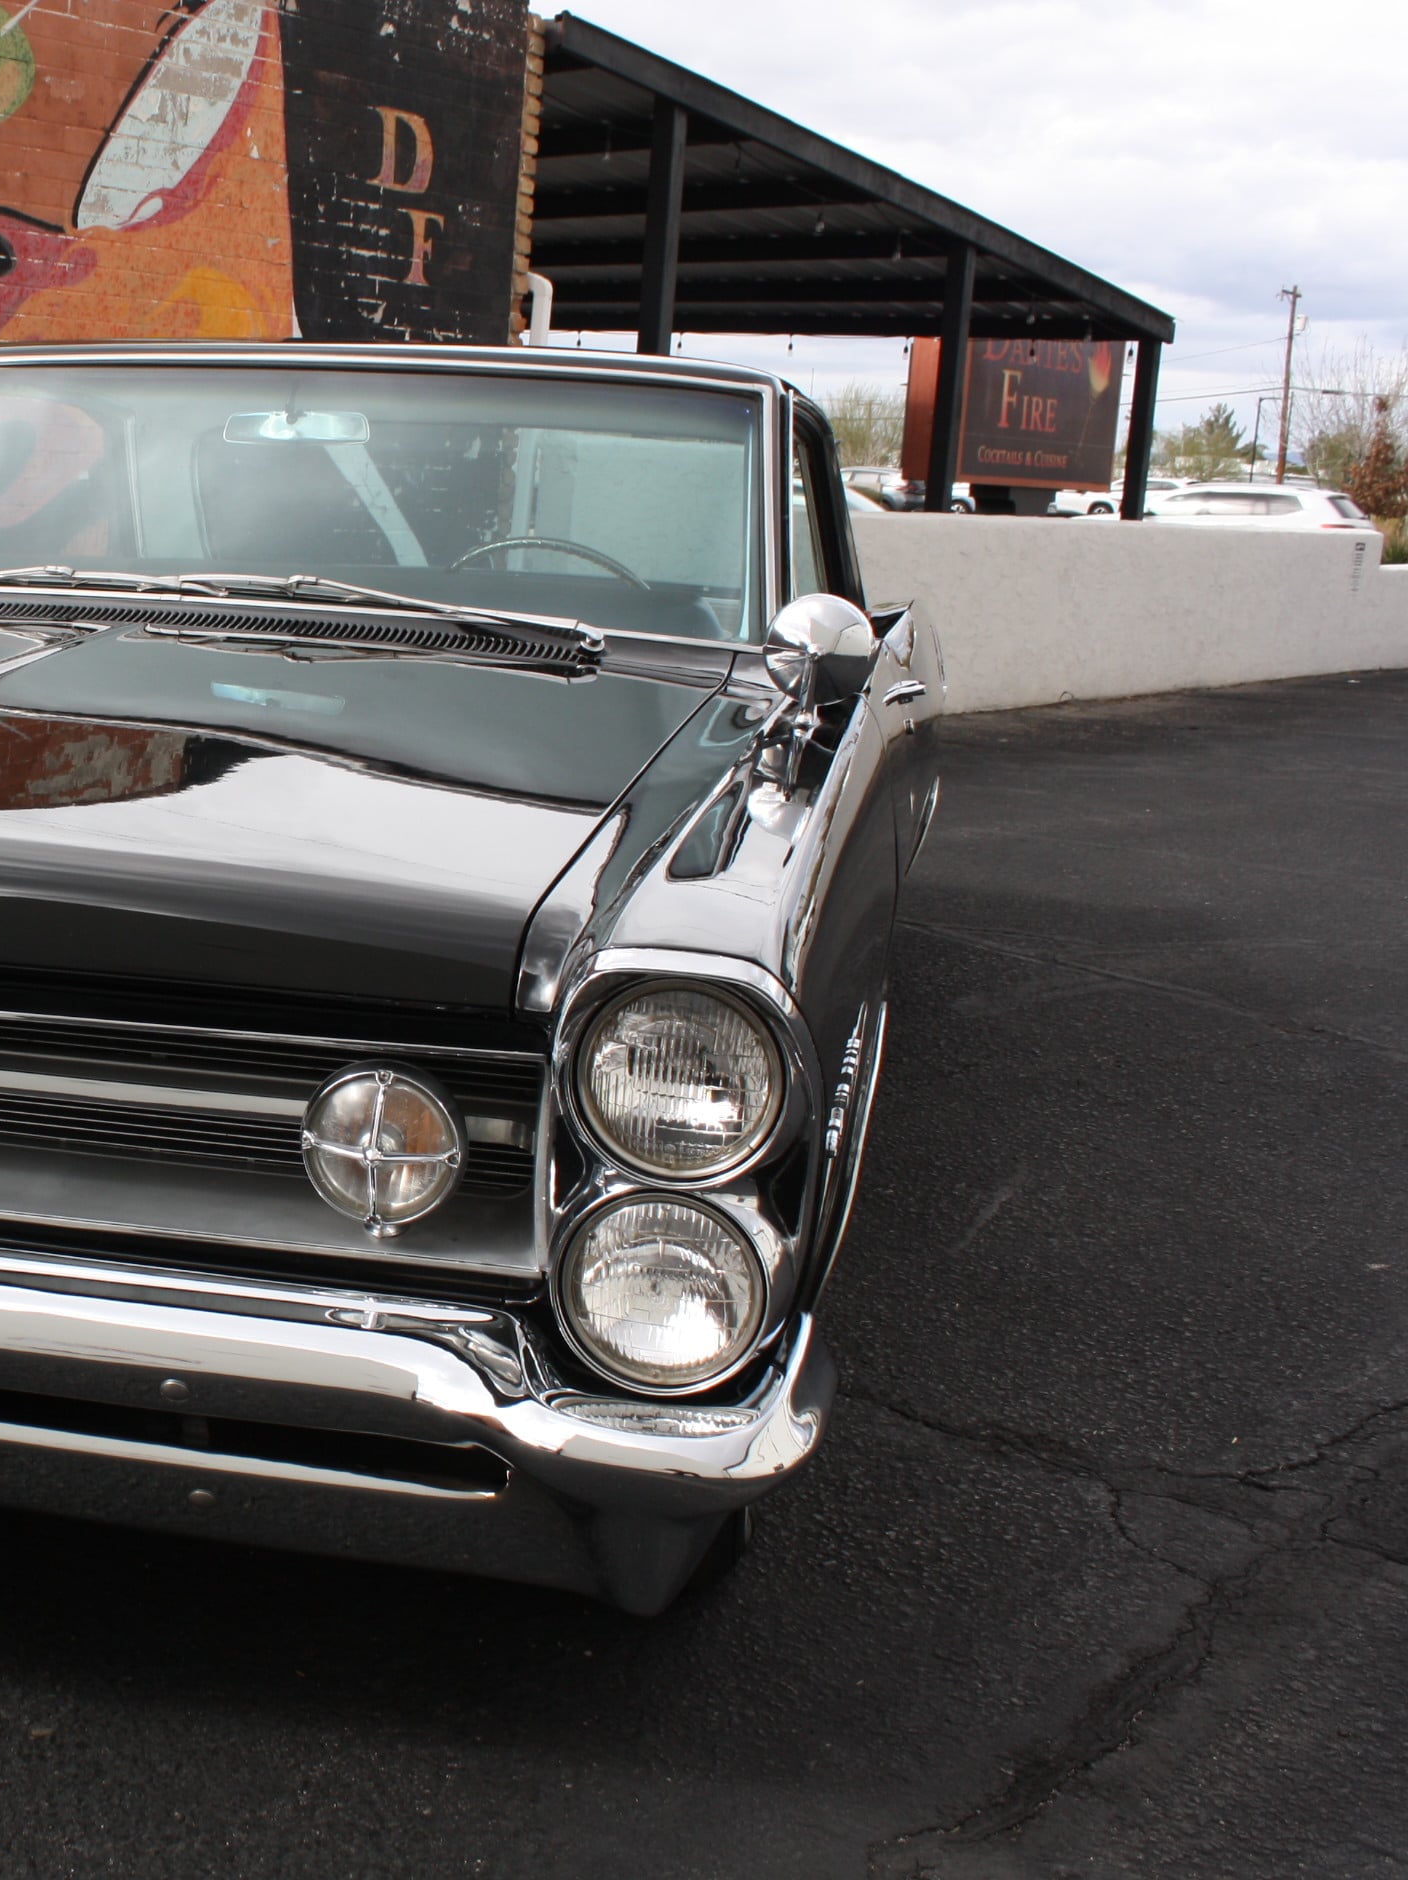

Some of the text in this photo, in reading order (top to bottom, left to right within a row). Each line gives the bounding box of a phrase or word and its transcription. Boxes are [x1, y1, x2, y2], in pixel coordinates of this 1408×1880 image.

[366, 105, 434, 194] D
[397, 208, 445, 287] F
[997, 369, 1058, 433] FIRE
